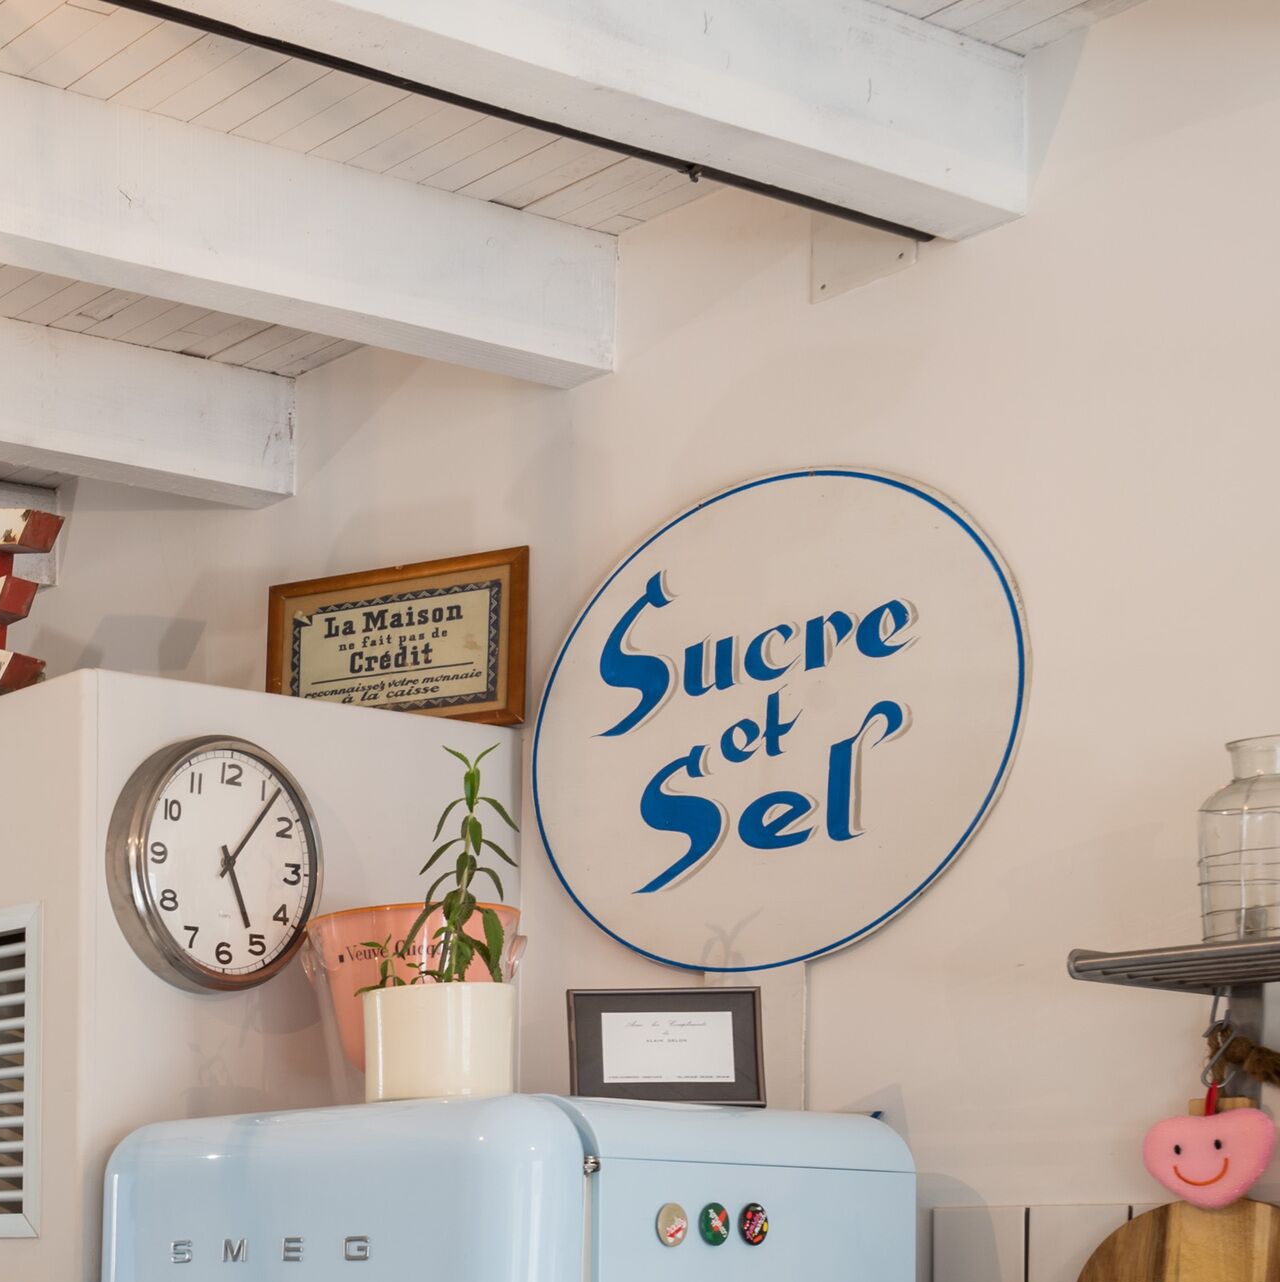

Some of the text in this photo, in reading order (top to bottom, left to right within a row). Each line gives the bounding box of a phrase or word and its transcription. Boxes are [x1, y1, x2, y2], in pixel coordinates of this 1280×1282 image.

[324, 605, 463, 638] La Maison
[339, 628, 448, 651] ne fait pas de
[350, 643, 433, 674] Crédit
[591, 569, 915, 738] Sucre
[304, 670, 482, 699] reconnaissez votre monnaie
[342, 684, 440, 704] à la caisse
[720, 685, 803, 763] et
[190, 772, 203, 794] 11
[221, 762, 243, 787] 12
[261, 780, 266, 801] 1
[631, 700, 912, 894] Sel
[164, 798, 181, 821] 10
[276, 817, 293, 839] 2
[150, 842, 168, 864] 9
[283, 863, 301, 886] 3
[160, 889, 178, 911] 8
[273, 904, 290, 926] 4
[184, 925, 199, 948] 7
[248, 934, 266, 956] 5
[215, 942, 232, 965] 6
[346, 944, 388, 961] Veuve
[170, 1235, 370, 1264] SMEG
